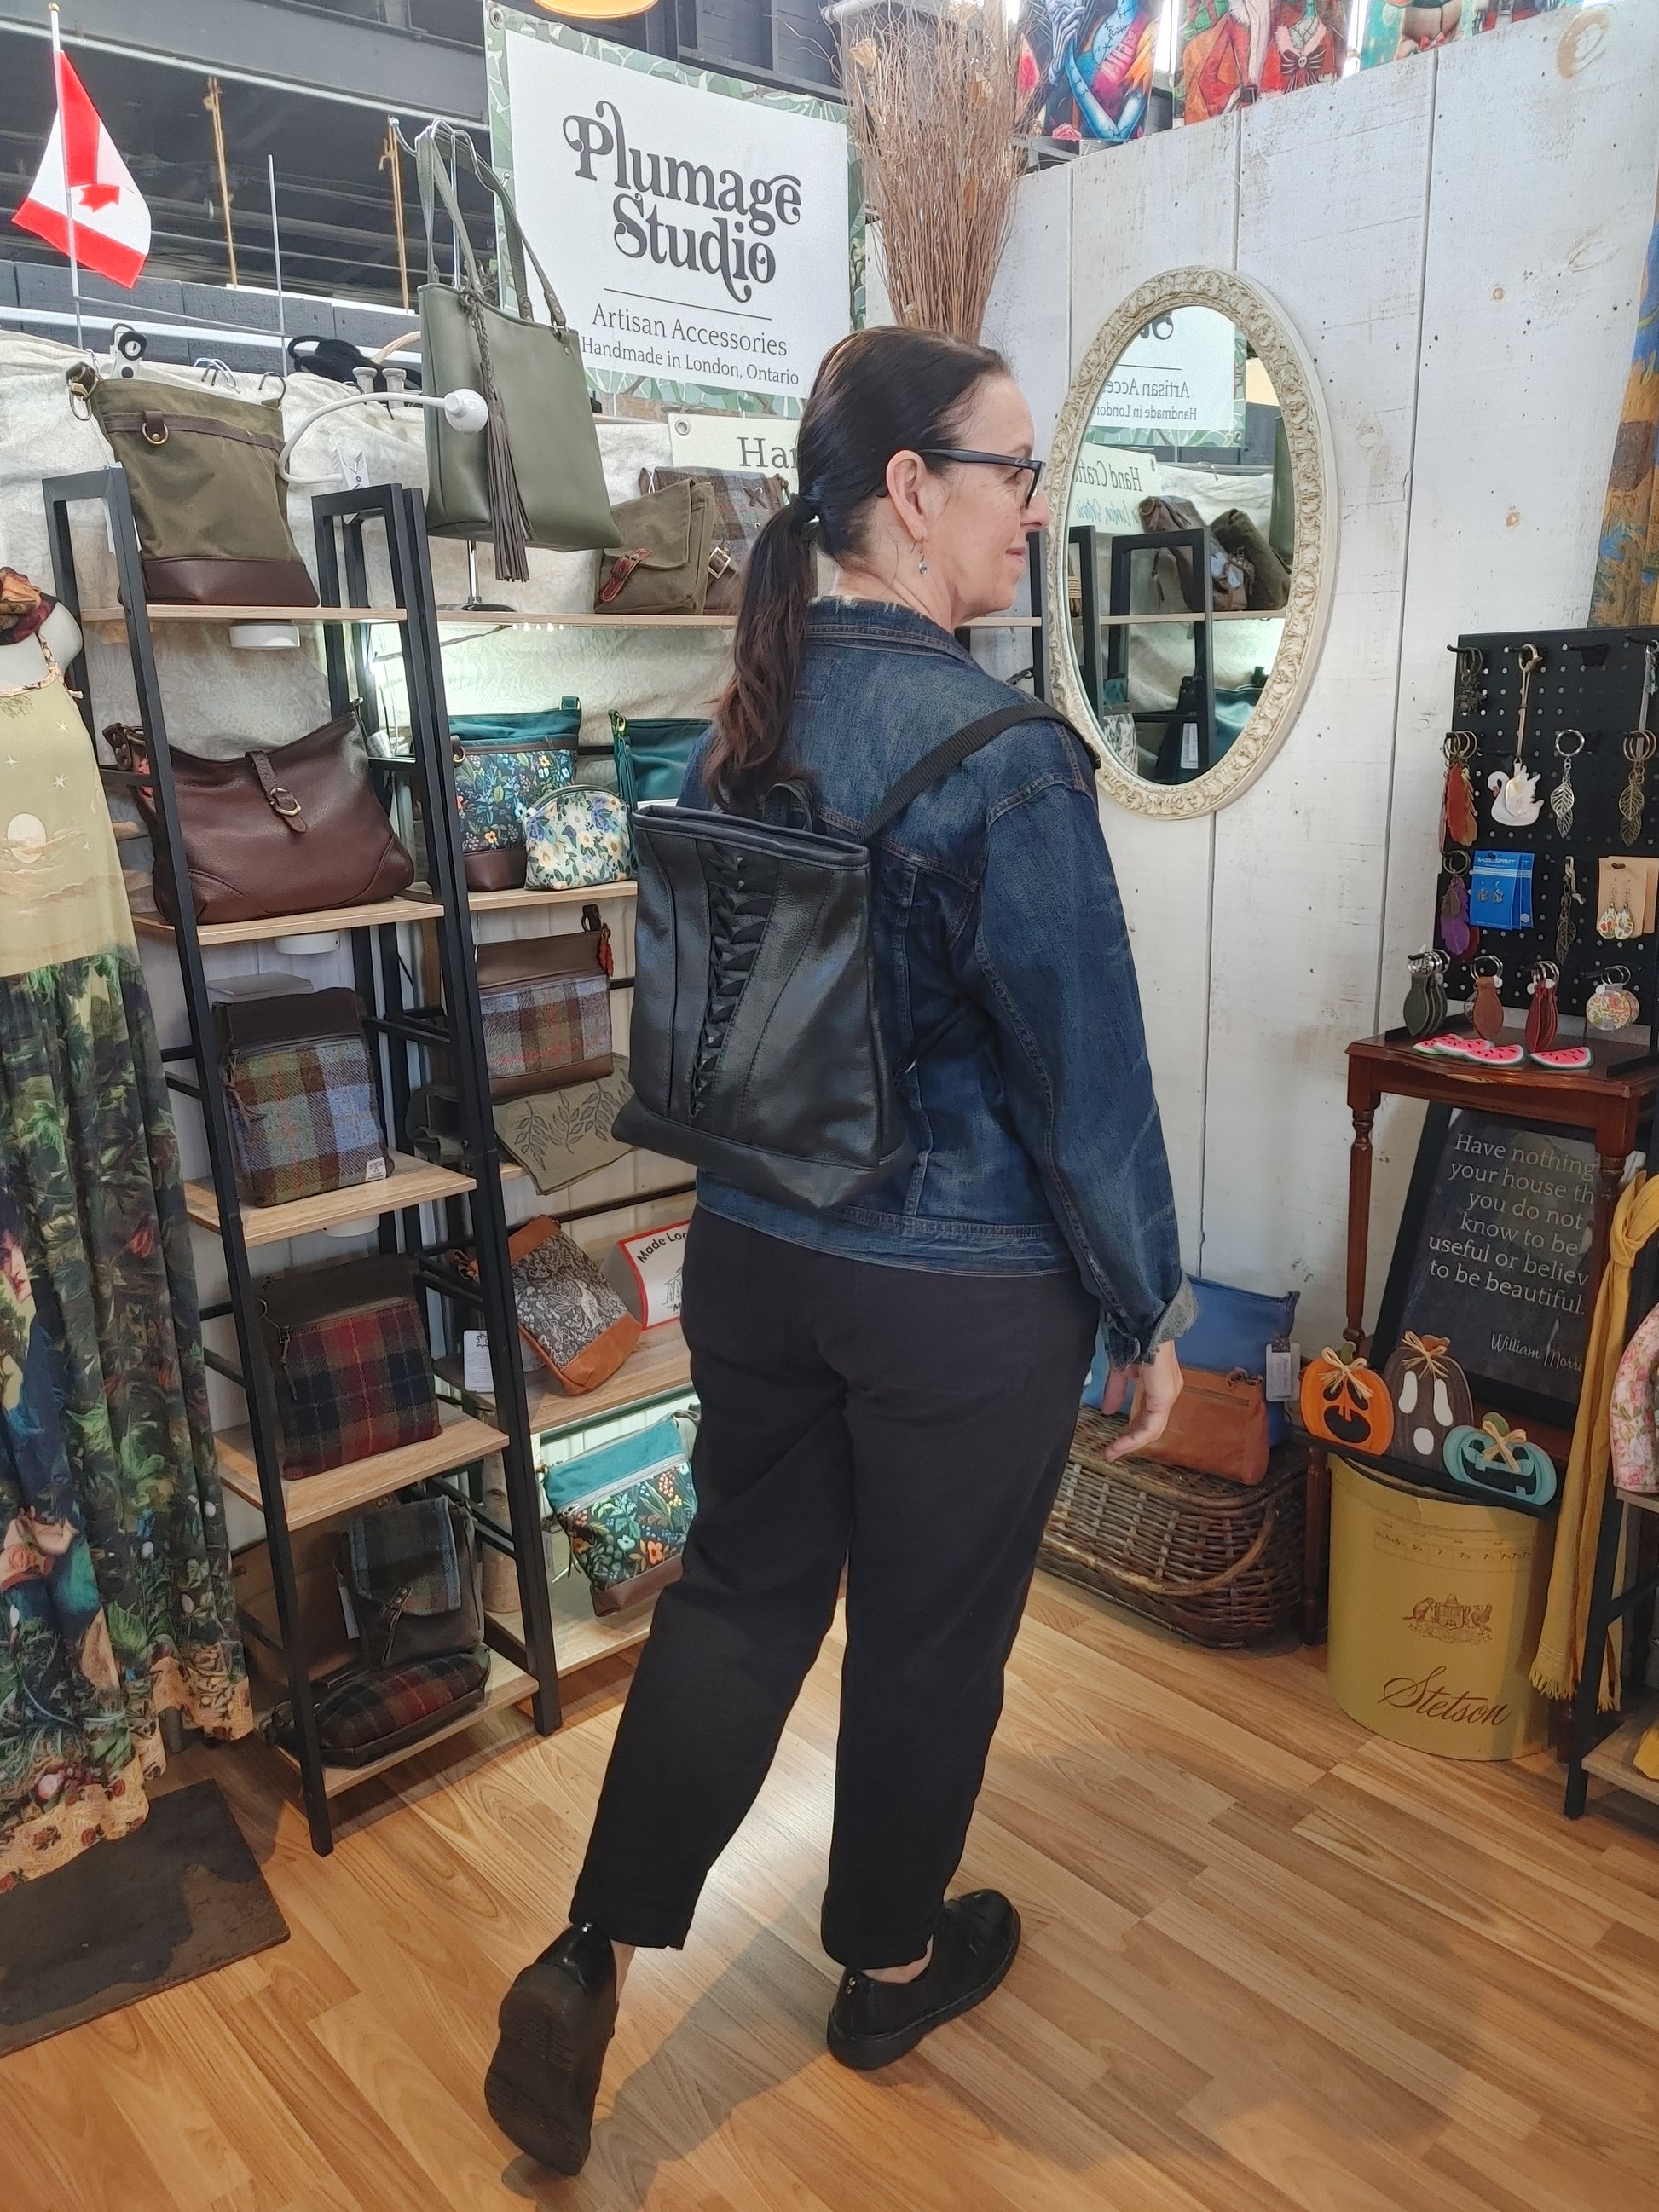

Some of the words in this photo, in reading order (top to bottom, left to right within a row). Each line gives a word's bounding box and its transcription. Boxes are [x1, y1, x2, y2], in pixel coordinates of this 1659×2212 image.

[563, 101, 801, 236] Plumage
[613, 193, 776, 303] Studio
[592, 303, 667, 338] Artisan
[671, 318, 788, 356] Accessories
[581, 336, 663, 367] Handmade
[668, 350, 681, 368] in
[685, 354, 743, 379] London,
[746, 364, 800, 385] Ontario
[1454, 1132, 1506, 1158] Have
[1511, 1148, 1597, 1182] nothing
[1448, 1161, 1498, 1181] your
[1501, 1168, 1567, 1198] house
[1573, 1182, 1595, 1205] th
[1459, 1211, 1519, 1243] know
[1523, 1227, 1545, 1248] to
[1551, 1233, 1577, 1256] be
[1467, 1191, 1506, 1212] you
[1512, 1198, 1540, 1220] do
[1546, 1210, 1583, 1230] not
[636, 1237, 667, 1264] Made
[667, 1232, 688, 1243] Loc
[1429, 1235, 1491, 1266] useful
[1495, 1250, 1518, 1269] or
[1523, 1253, 1590, 1287] believ
[1430, 1259, 1450, 1279] to
[1454, 1265, 1481, 1287] be
[1484, 1271, 1586, 1316] beautiful.
[1491, 1331, 1540, 1360] William
[1544, 1344, 1583, 1372] Morri
[1378, 1666, 1512, 1726] Stetson
